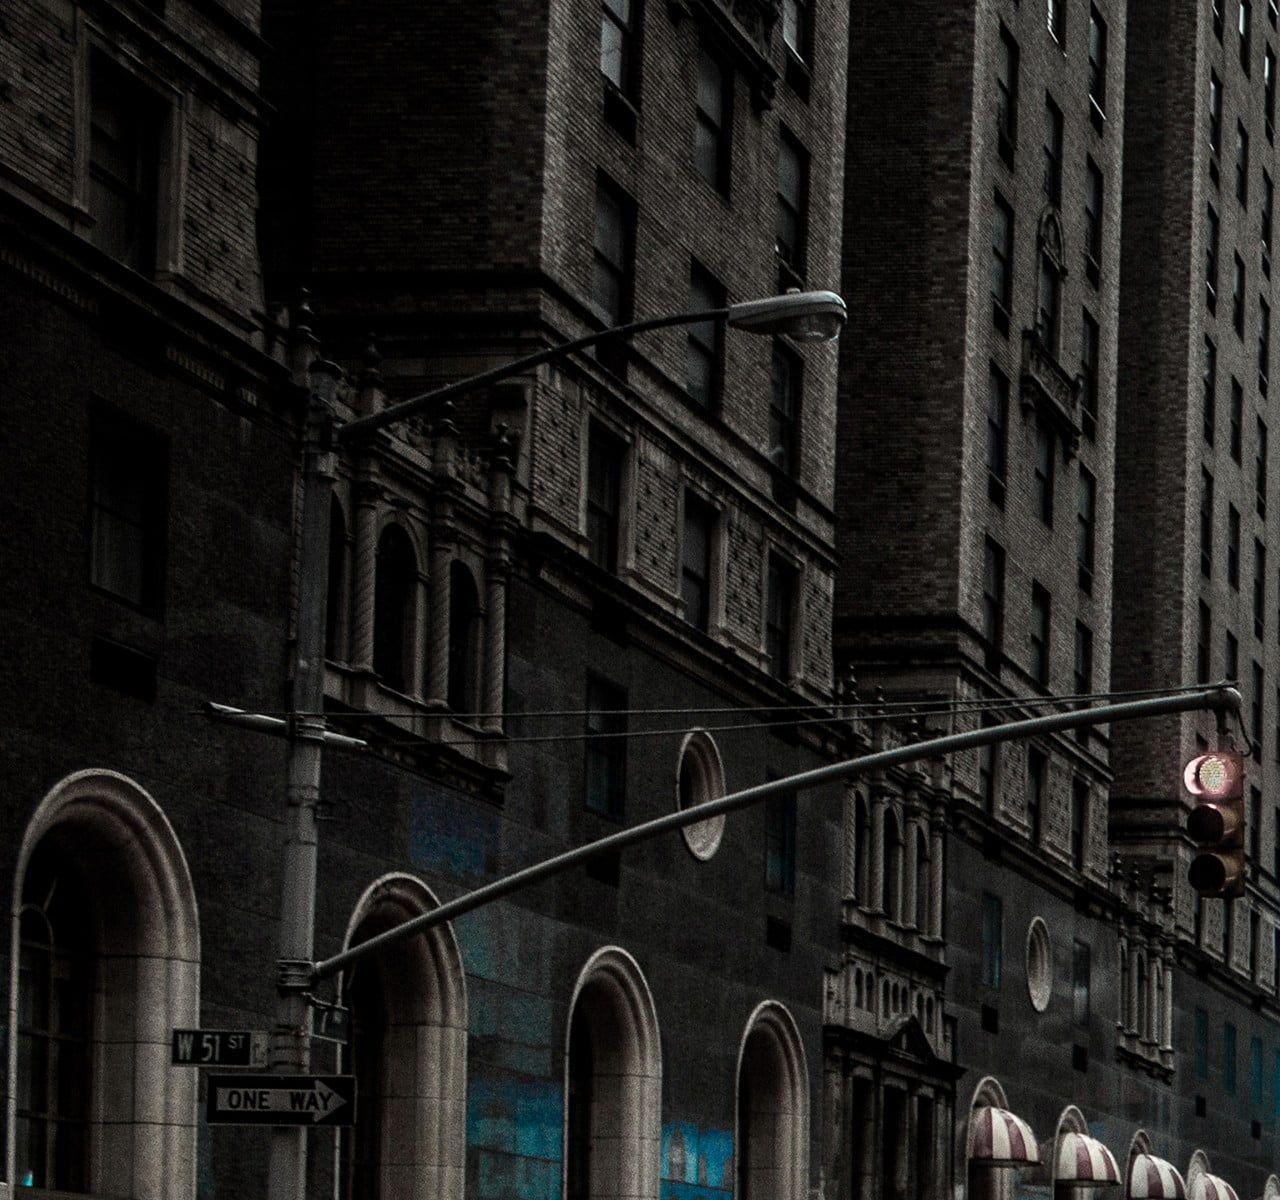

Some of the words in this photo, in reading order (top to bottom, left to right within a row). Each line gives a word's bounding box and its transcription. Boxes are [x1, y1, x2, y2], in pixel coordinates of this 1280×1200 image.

[178, 1034, 193, 1060] W
[202, 1034, 220, 1061] 51
[228, 1035, 244, 1049] ST
[228, 1090, 270, 1109] ONE
[290, 1091, 333, 1110] WAY
